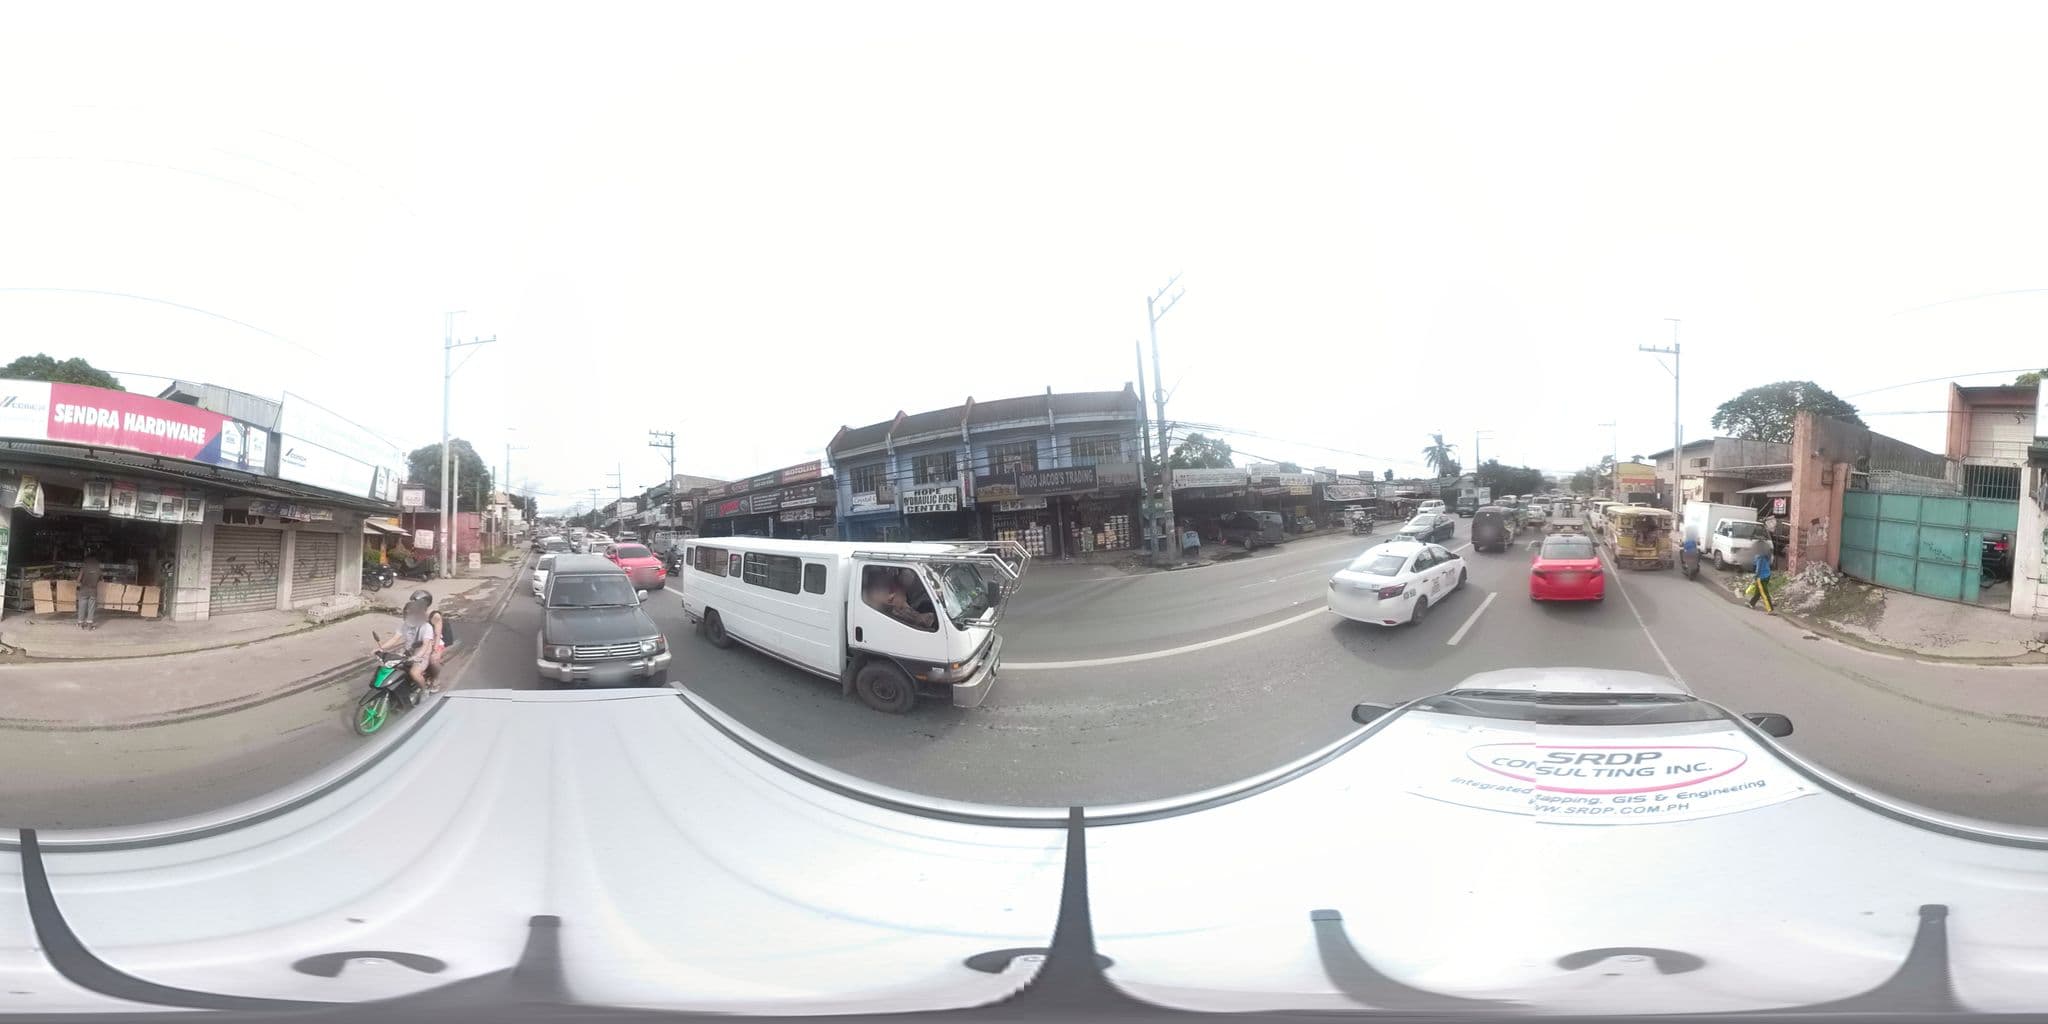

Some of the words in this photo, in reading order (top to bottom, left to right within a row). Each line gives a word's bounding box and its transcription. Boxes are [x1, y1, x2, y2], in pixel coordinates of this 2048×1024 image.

[54, 403, 119, 430] SENDRA
[124, 412, 206, 445] HARDWARE
[1037, 472, 1065, 488] JACOB'S
[1065, 470, 1093, 485] TRADING
[914, 487, 942, 496] HOPE
[938, 493, 956, 504] HOSE
[907, 503, 951, 513] CENTER
[1543, 752, 1662, 766] SRDP
[1666, 762, 1713, 775] INC.
[1450, 777, 1535, 795] Integrated
[1612, 795, 1647, 804] GIS
[1655, 793, 1669, 802] &
[1676, 779, 1767, 800] Engineering
